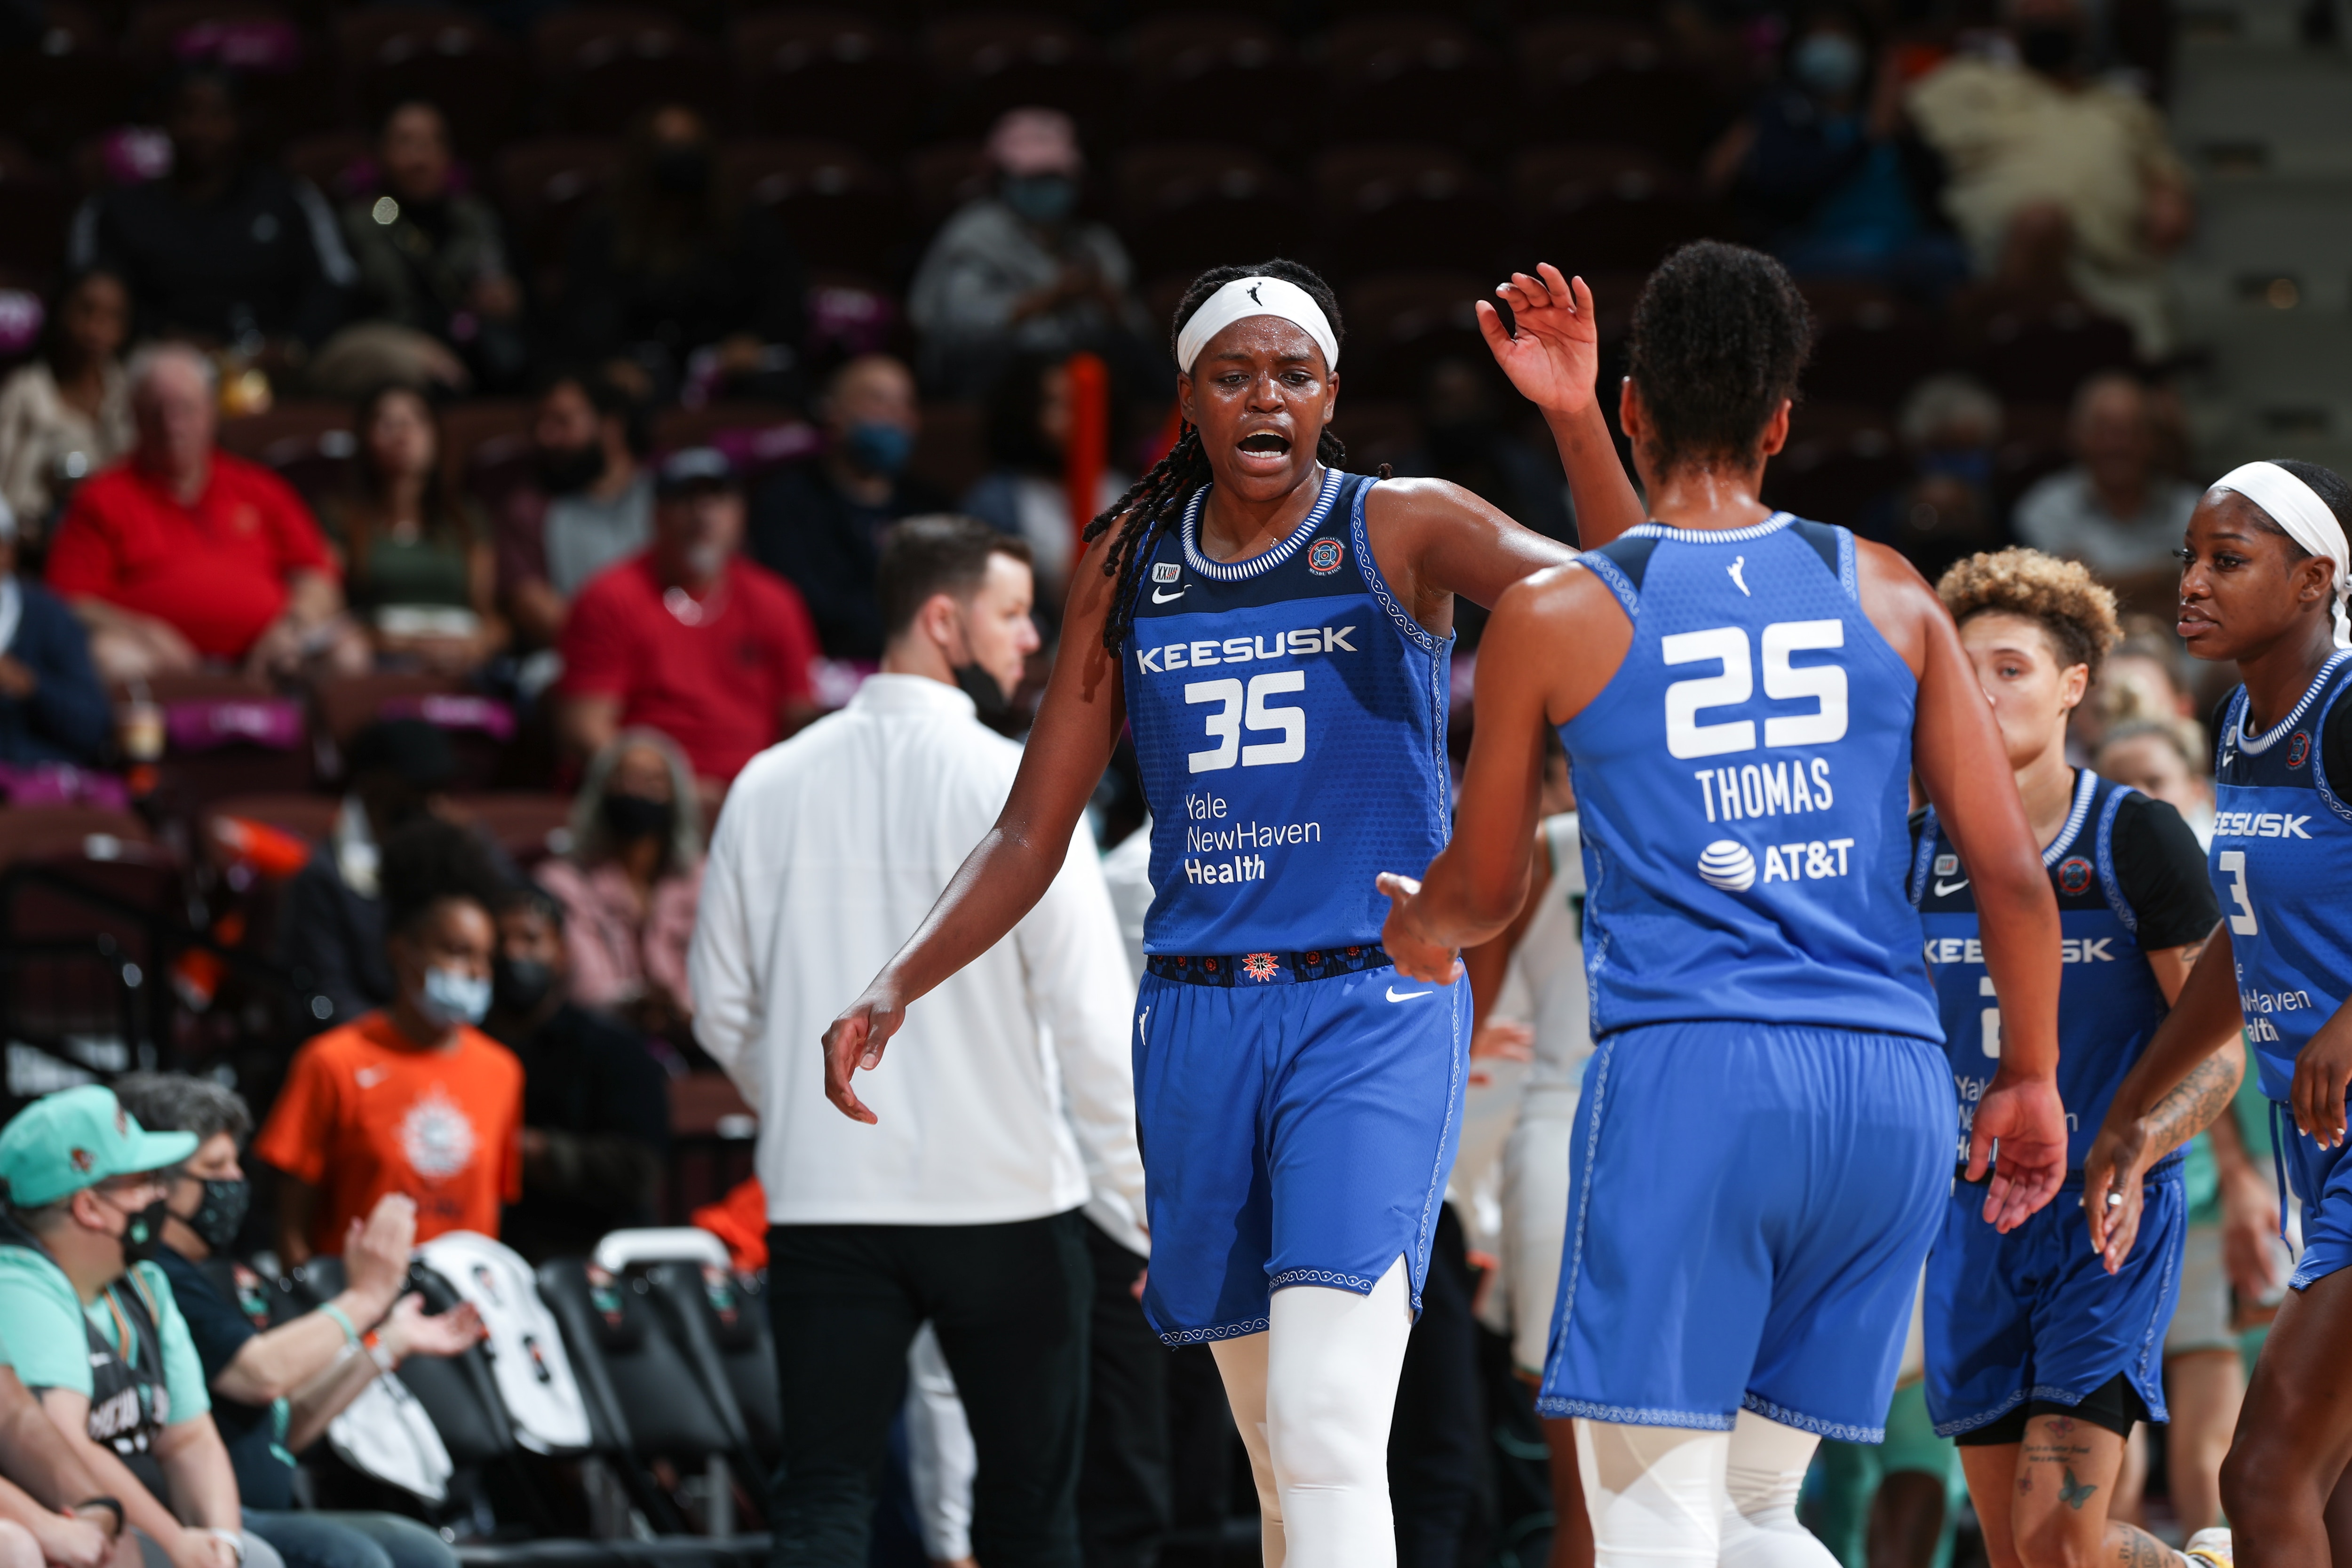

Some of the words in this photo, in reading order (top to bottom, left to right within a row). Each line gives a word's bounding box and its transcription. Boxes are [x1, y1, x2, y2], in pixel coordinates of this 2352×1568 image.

[1136, 626, 1358, 675] KEESUSK
[1661, 618, 1849, 760] 25
[1184, 670, 1305, 774] 35
[1185, 792, 1227, 820] Yale
[1694, 757, 1834, 823] THOMAS
[1187, 821, 1321, 853] NewHaven
[2213, 812, 2313, 839] EESUSK
[1184, 854, 1265, 884] Health
[1763, 837, 1855, 884] AT&T
[2219, 851, 2258, 935] 3
[1924, 938, 2115, 964] KEESK
[1954, 1075, 1990, 1101] Yal
